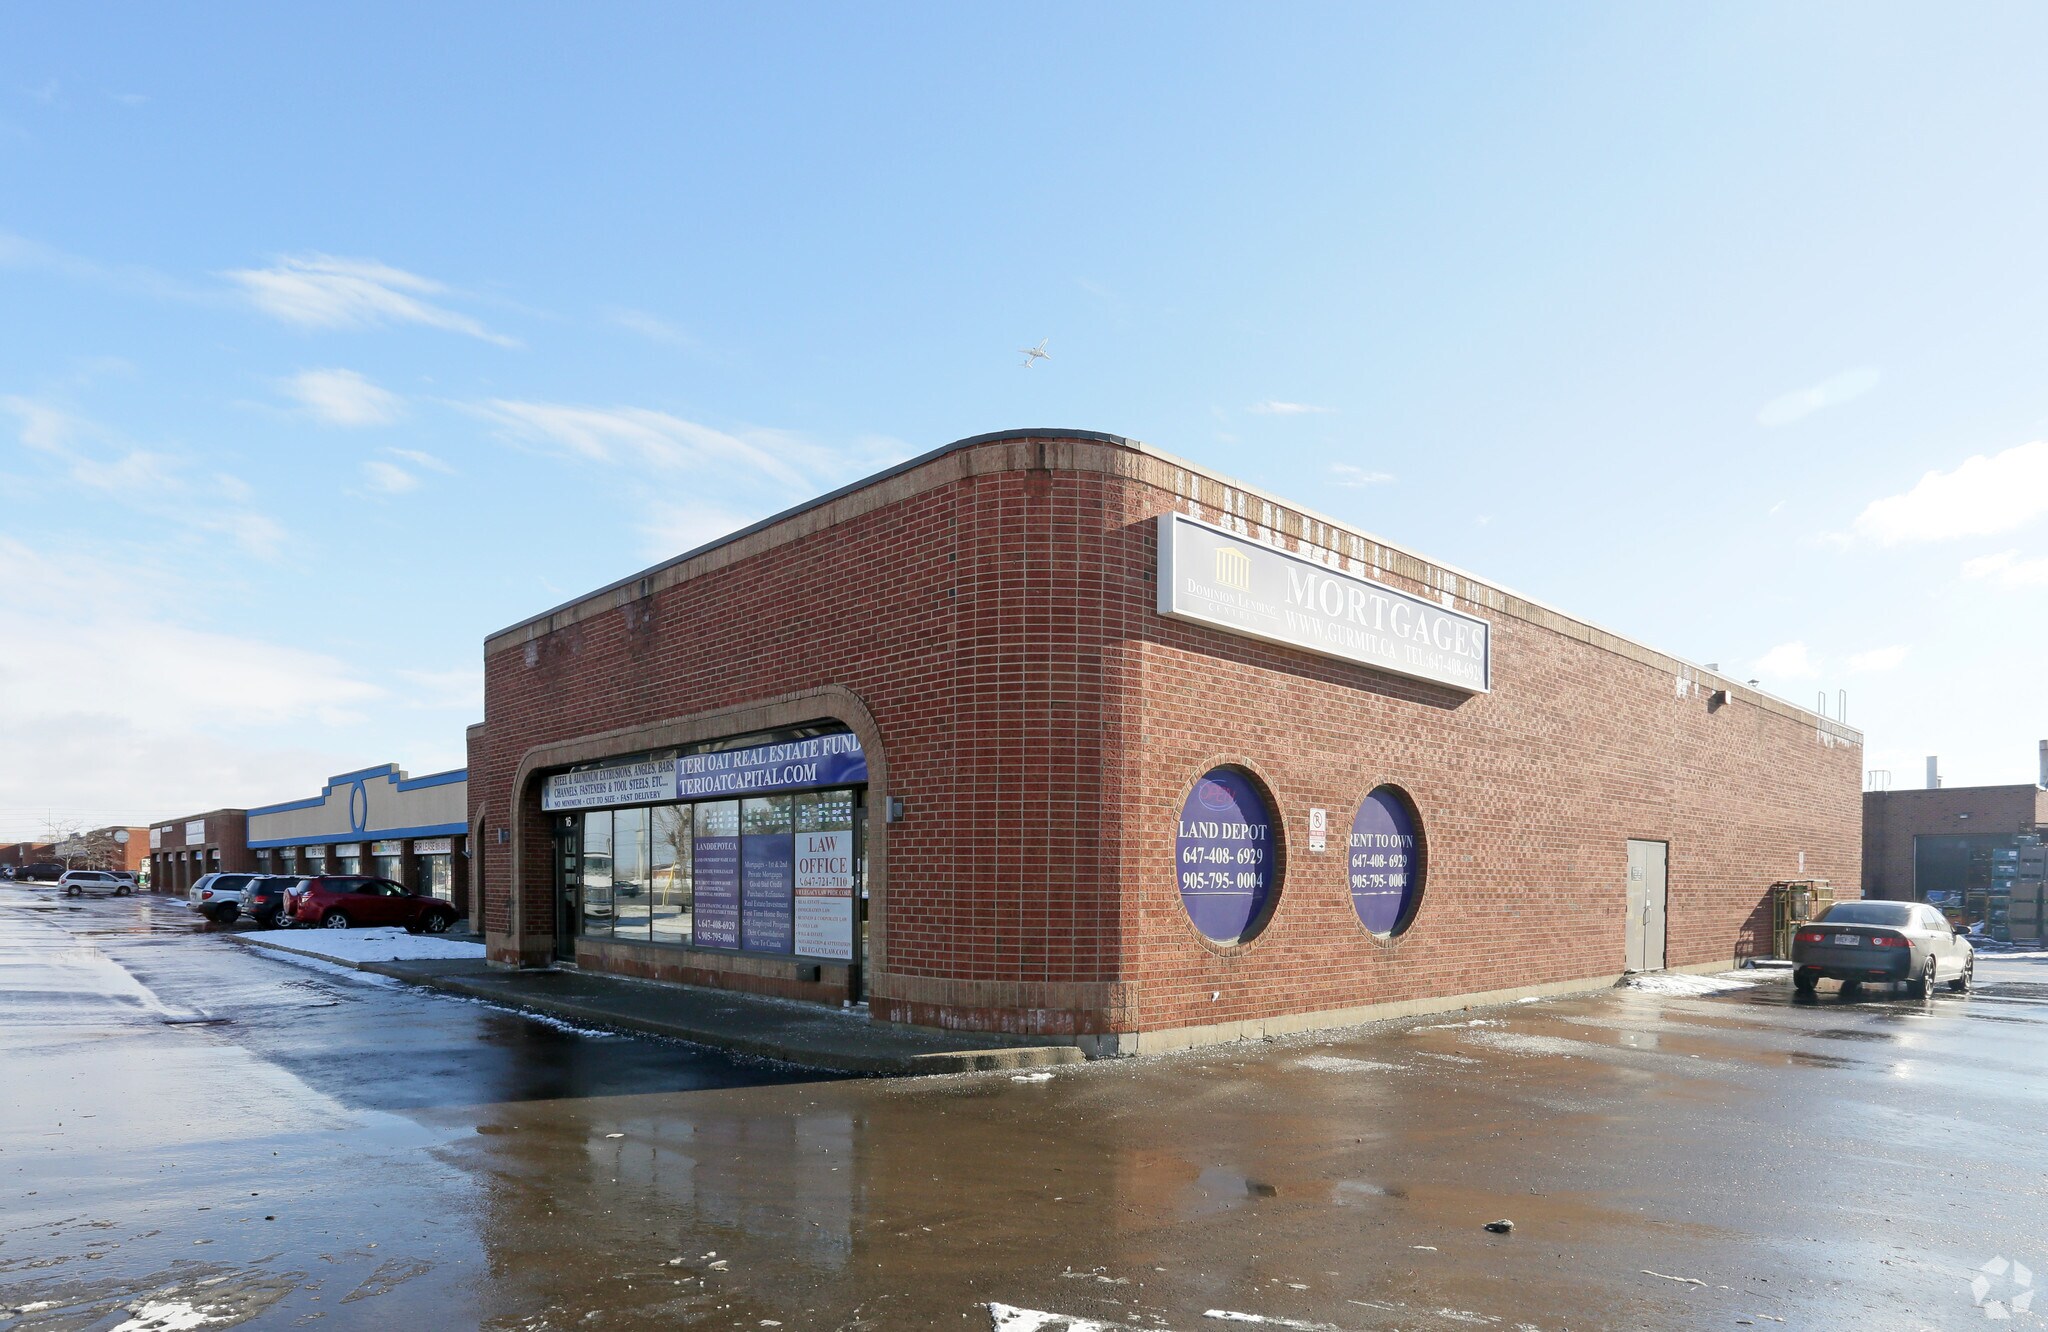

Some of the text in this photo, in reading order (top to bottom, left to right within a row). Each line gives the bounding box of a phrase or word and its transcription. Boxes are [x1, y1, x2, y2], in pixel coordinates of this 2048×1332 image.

[1285, 566, 1483, 661] MORTGAGES
[680, 757, 705, 775] TERI
[707, 752, 731, 771] OAT
[733, 747, 767, 768] REAL
[769, 739, 819, 763] ESTATE
[554, 775, 567, 786] STEEL
[634, 762, 655, 776] ANGLES,
[659, 760, 675, 773] BARS,
[680, 763, 817, 795] TERIOATCAPITAL.COM
[555, 784, 578, 798] CHANNELS,
[580, 782, 606, 795] FASTENERS
[614, 780, 627, 791] TOOL
[629, 777, 649, 790] STEELS,
[586, 796, 595, 805] CUT
[597, 796, 604, 804] TO
[604, 795, 615, 803] SIZE
[620, 793, 633, 801] FAST
[634, 790, 662, 800] DELIVERY
[1179, 821, 1267, 841] LAND DEPOT
[808, 836, 838, 853] LAW
[1376, 833, 1389, 848] TO
[1391, 834, 1413, 848] OWN
[1237, 848, 1263, 865] 6929
[1389, 854, 1408, 868] 6929
[799, 857, 848, 874] OFFICE
[804, 877, 847, 887] 647-721-7110
[1237, 872, 1263, 889] 0004
[1389, 873, 1408, 888] 0004
